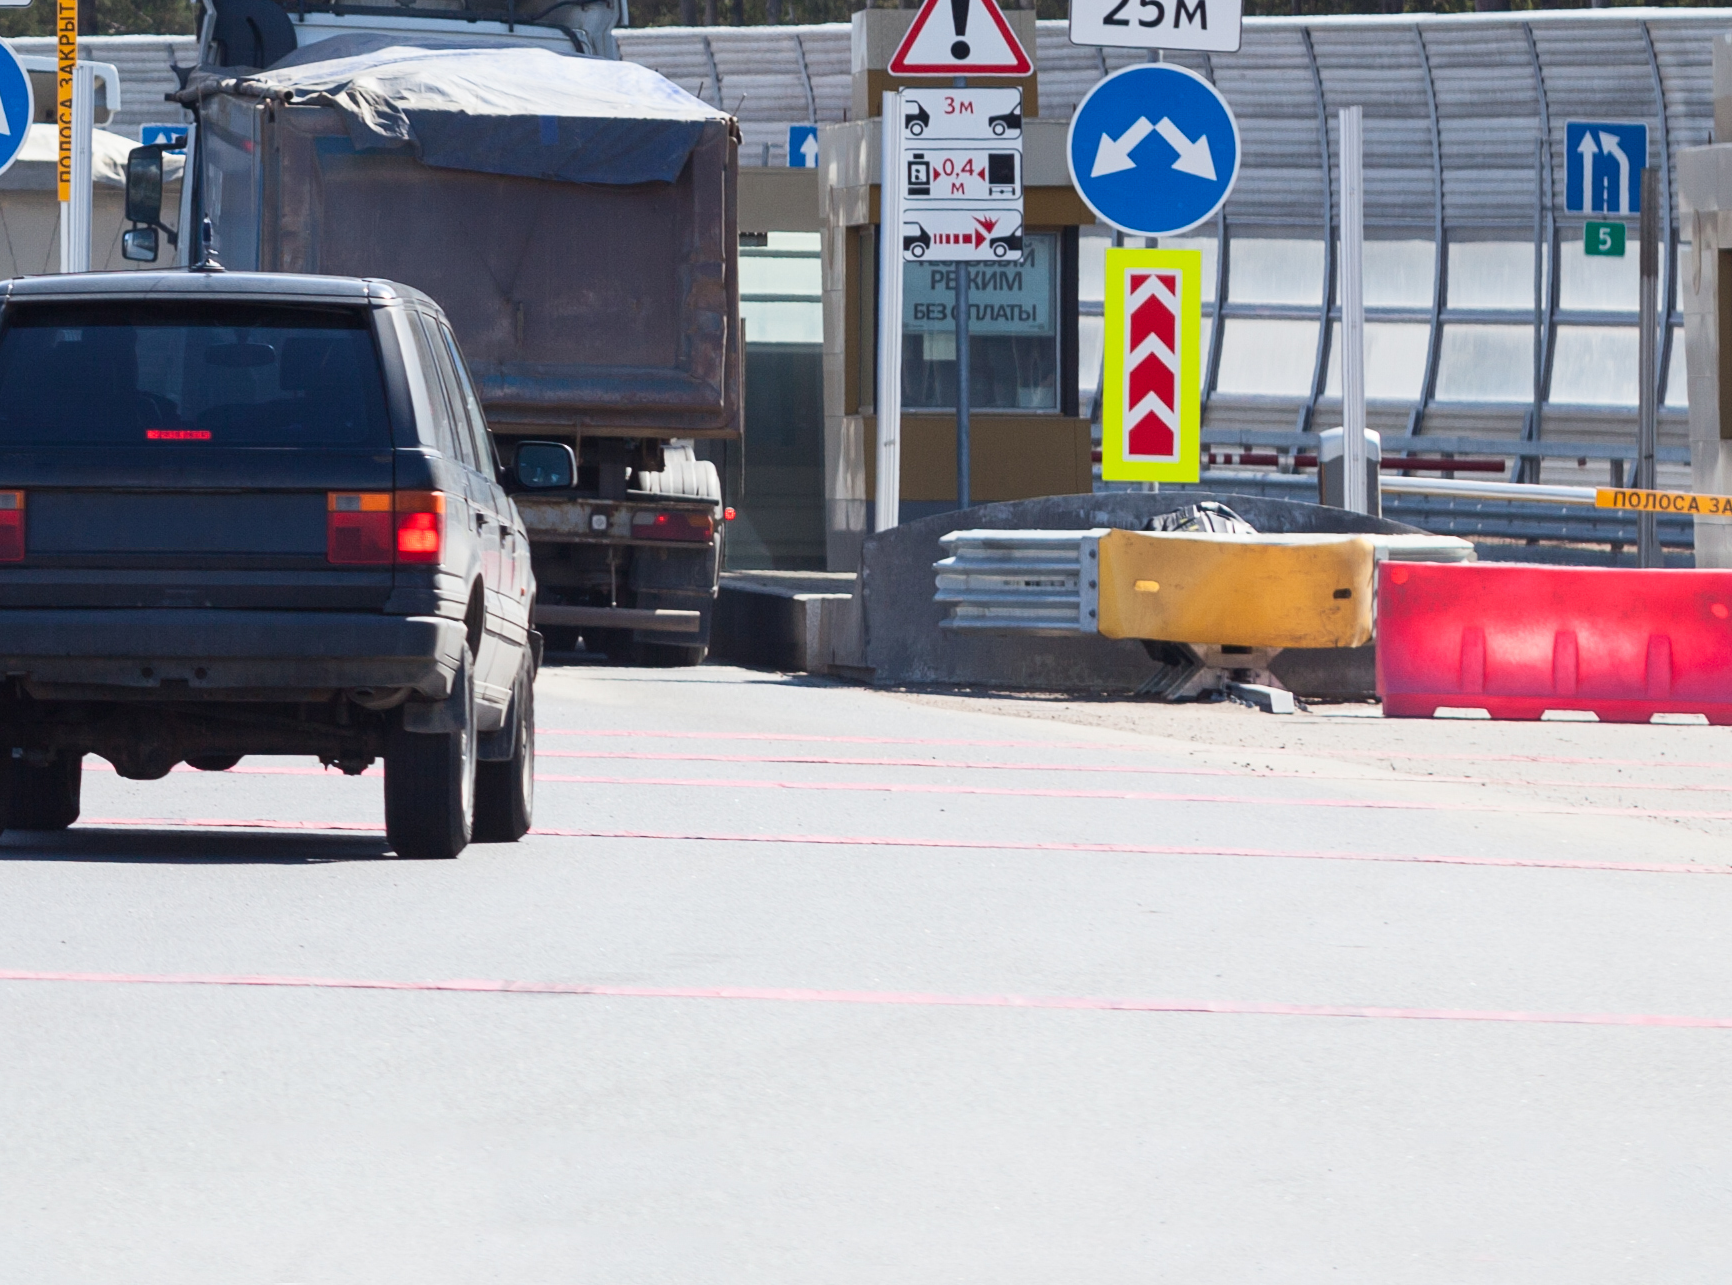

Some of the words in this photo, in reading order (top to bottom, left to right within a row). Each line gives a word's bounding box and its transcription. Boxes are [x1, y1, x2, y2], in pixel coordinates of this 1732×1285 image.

[942, 158, 975, 179] 0,4
[1598, 227, 1612, 251] 5
[913, 303, 948, 321] БЕЗ
[1613, 491, 1700, 513] ПОЛОСА
